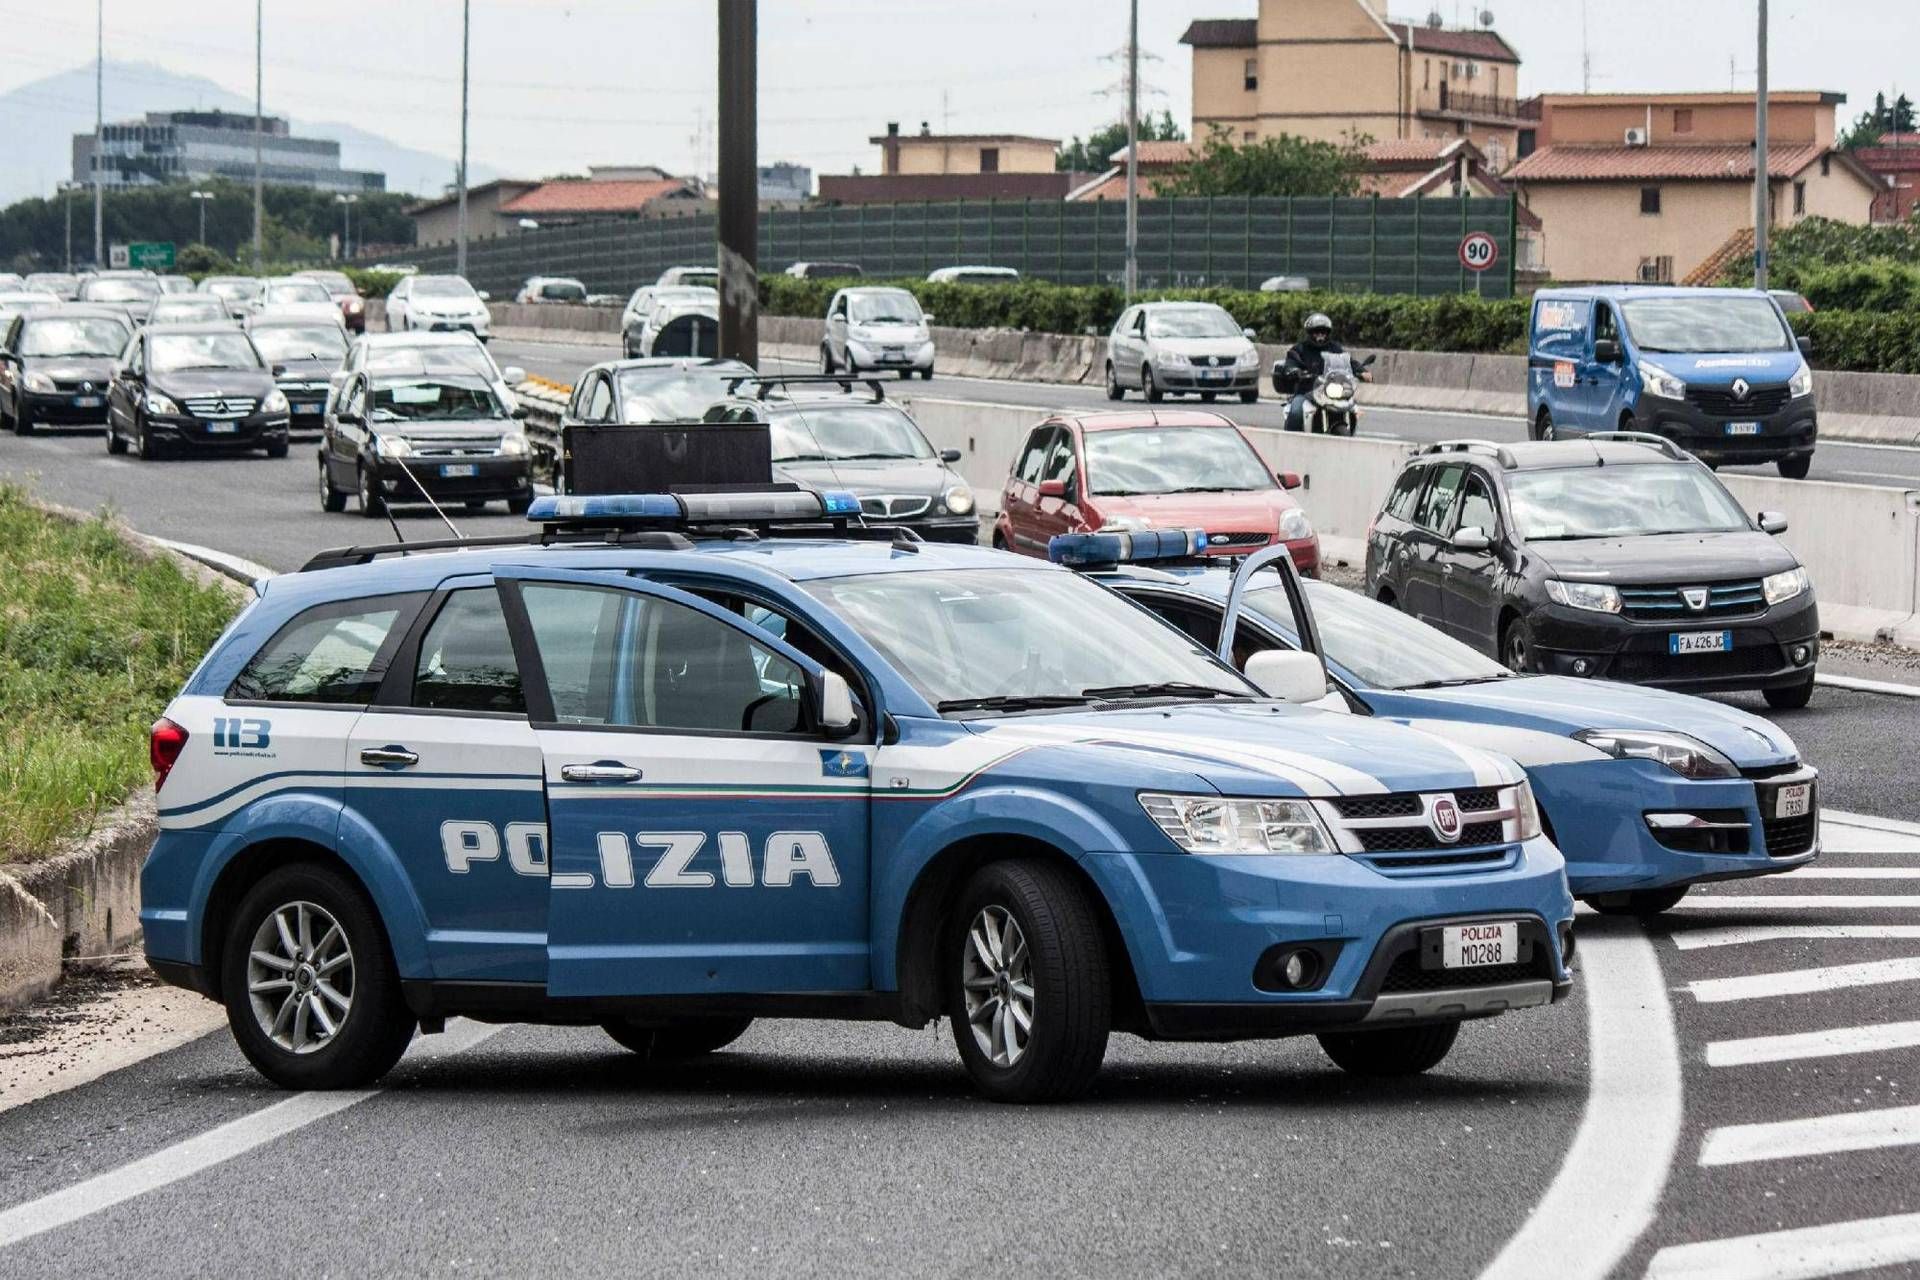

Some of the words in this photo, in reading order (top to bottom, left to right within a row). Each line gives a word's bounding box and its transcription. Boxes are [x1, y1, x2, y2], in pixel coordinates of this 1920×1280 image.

[1468, 243, 1489, 260] 90
[214, 718, 271, 748] 113
[1785, 786, 1804, 798] POLIZIA
[1439, 808, 1456, 826] FIAT
[1461, 926, 1502, 940] POLIZIA
